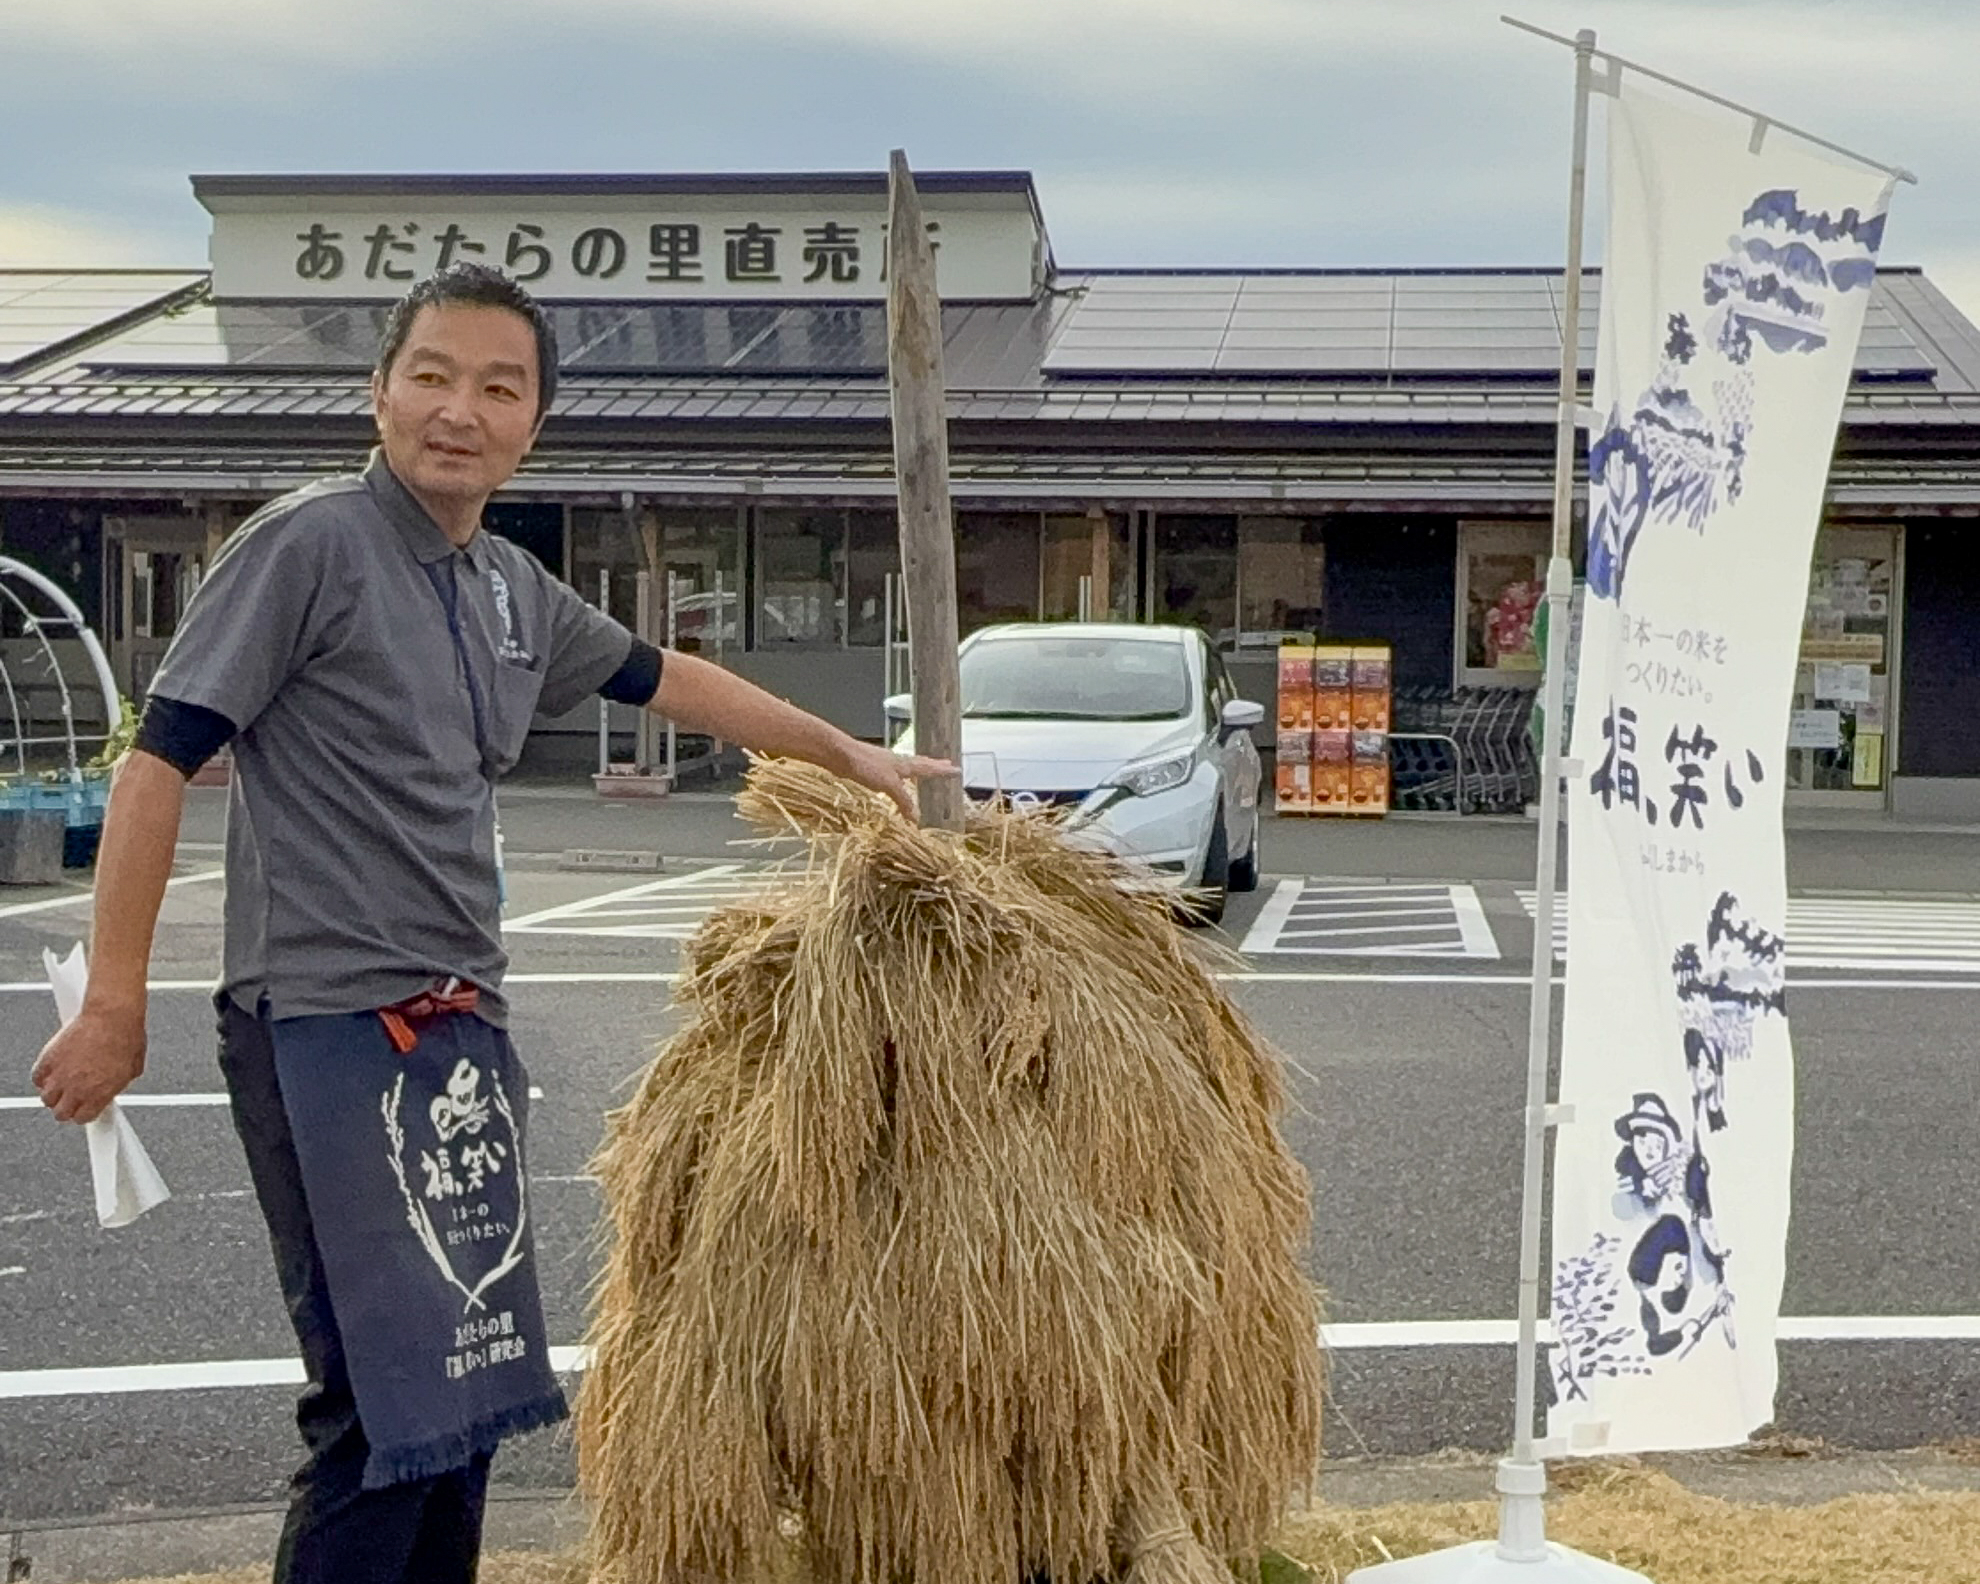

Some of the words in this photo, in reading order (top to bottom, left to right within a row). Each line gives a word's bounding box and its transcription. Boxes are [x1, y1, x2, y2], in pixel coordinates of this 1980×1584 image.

[1621, 613, 1728, 664] 日本一の米を
[1626, 660, 1713, 704] つくりたい。
